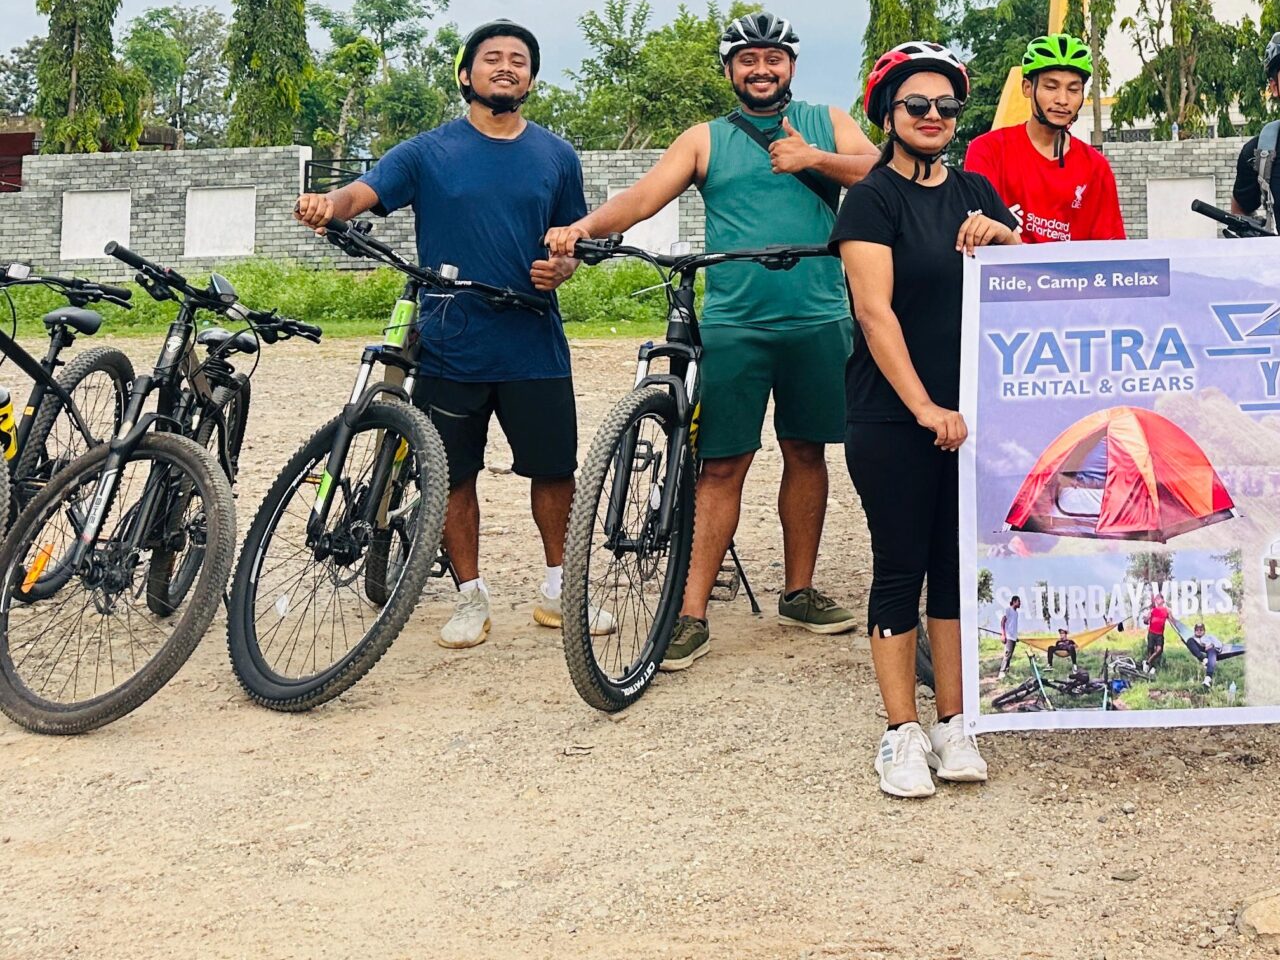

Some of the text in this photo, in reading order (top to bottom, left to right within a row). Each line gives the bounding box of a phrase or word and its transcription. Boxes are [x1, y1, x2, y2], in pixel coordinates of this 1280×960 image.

[1025, 222, 1071, 241] chartered
[1027, 213, 1070, 232] standard
[988, 272, 1159, 293] Ride, Camp & Relax
[988, 327, 1194, 376] YATRA
[1003, 376, 1194, 398] RENTAL & GEARS
[994, 579, 1234, 621] SATURDAY VIBES
